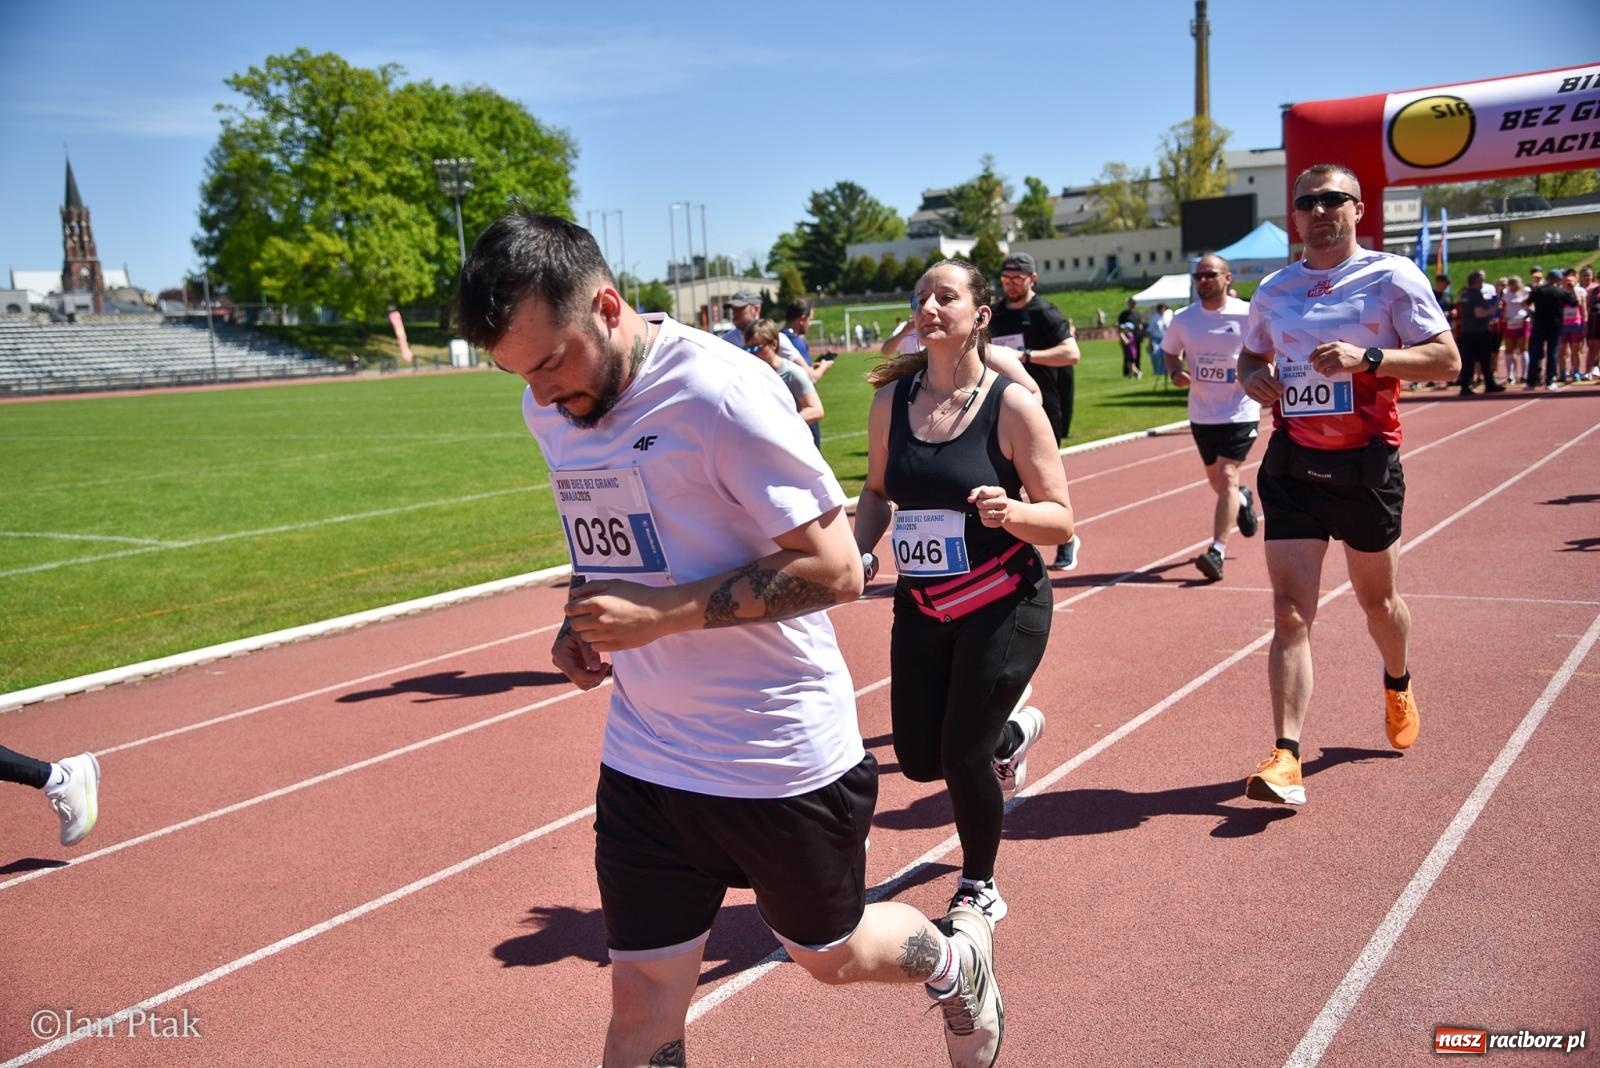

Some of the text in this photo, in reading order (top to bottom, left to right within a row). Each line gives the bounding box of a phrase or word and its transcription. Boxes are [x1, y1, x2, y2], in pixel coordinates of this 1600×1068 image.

[1499, 104, 1566, 131] BEZ
[1200, 367, 1224, 379] 076
[1286, 384, 1330, 406] 040
[633, 435, 658, 451] 4F
[571, 479, 584, 489] BIEG
[584, 478, 595, 489] BEZ
[595, 477, 620, 488] GRANIC
[923, 514, 945, 522] GRANIC
[574, 517, 632, 556] 036
[898, 539, 942, 564] 046
